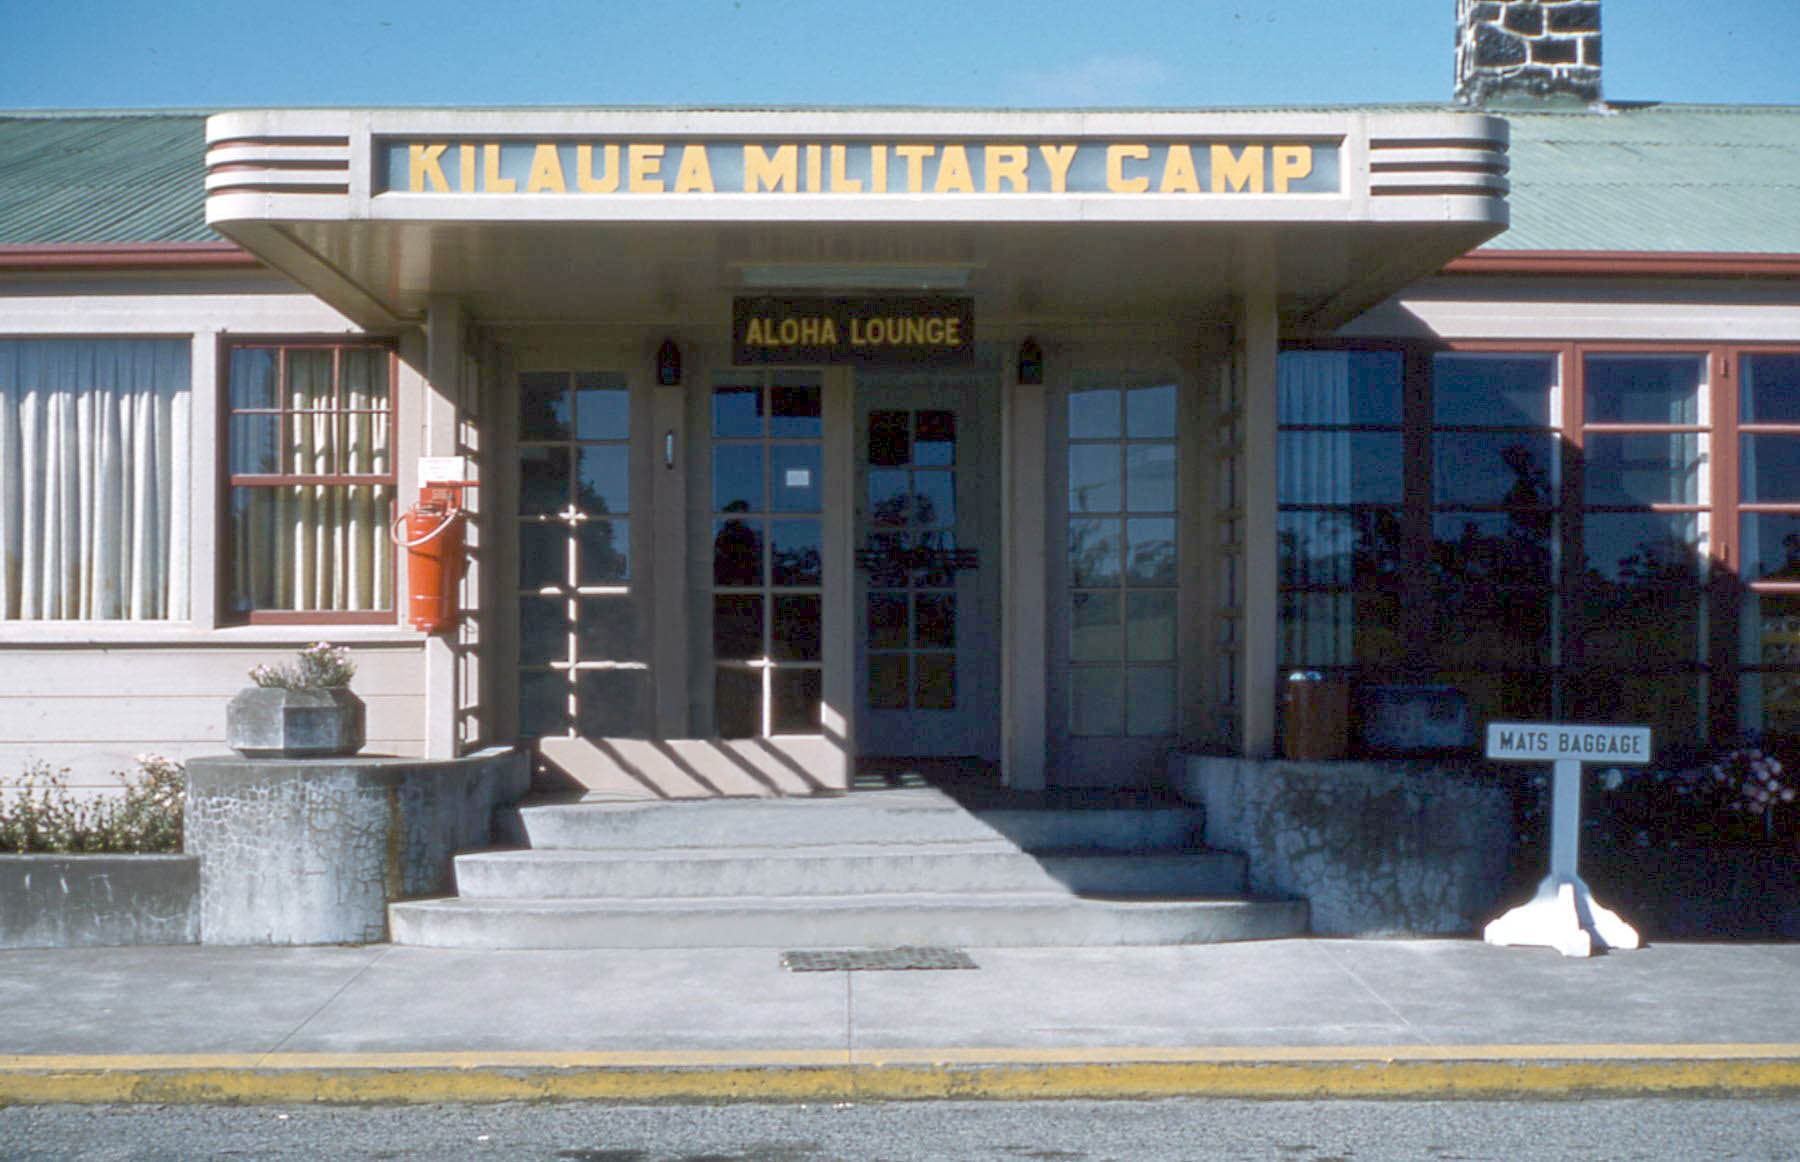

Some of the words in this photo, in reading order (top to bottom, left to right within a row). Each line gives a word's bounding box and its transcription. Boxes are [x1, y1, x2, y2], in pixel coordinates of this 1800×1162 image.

[408, 144, 715, 193] KILAUEA
[743, 144, 1078, 193] MILITARY
[1106, 144, 1313, 193] CAMP
[746, 317, 837, 345] ALOHA
[850, 317, 962, 345] LOUNGE
[1500, 731, 1549, 751] MATS
[1558, 733, 1641, 754] BAGGAGE
